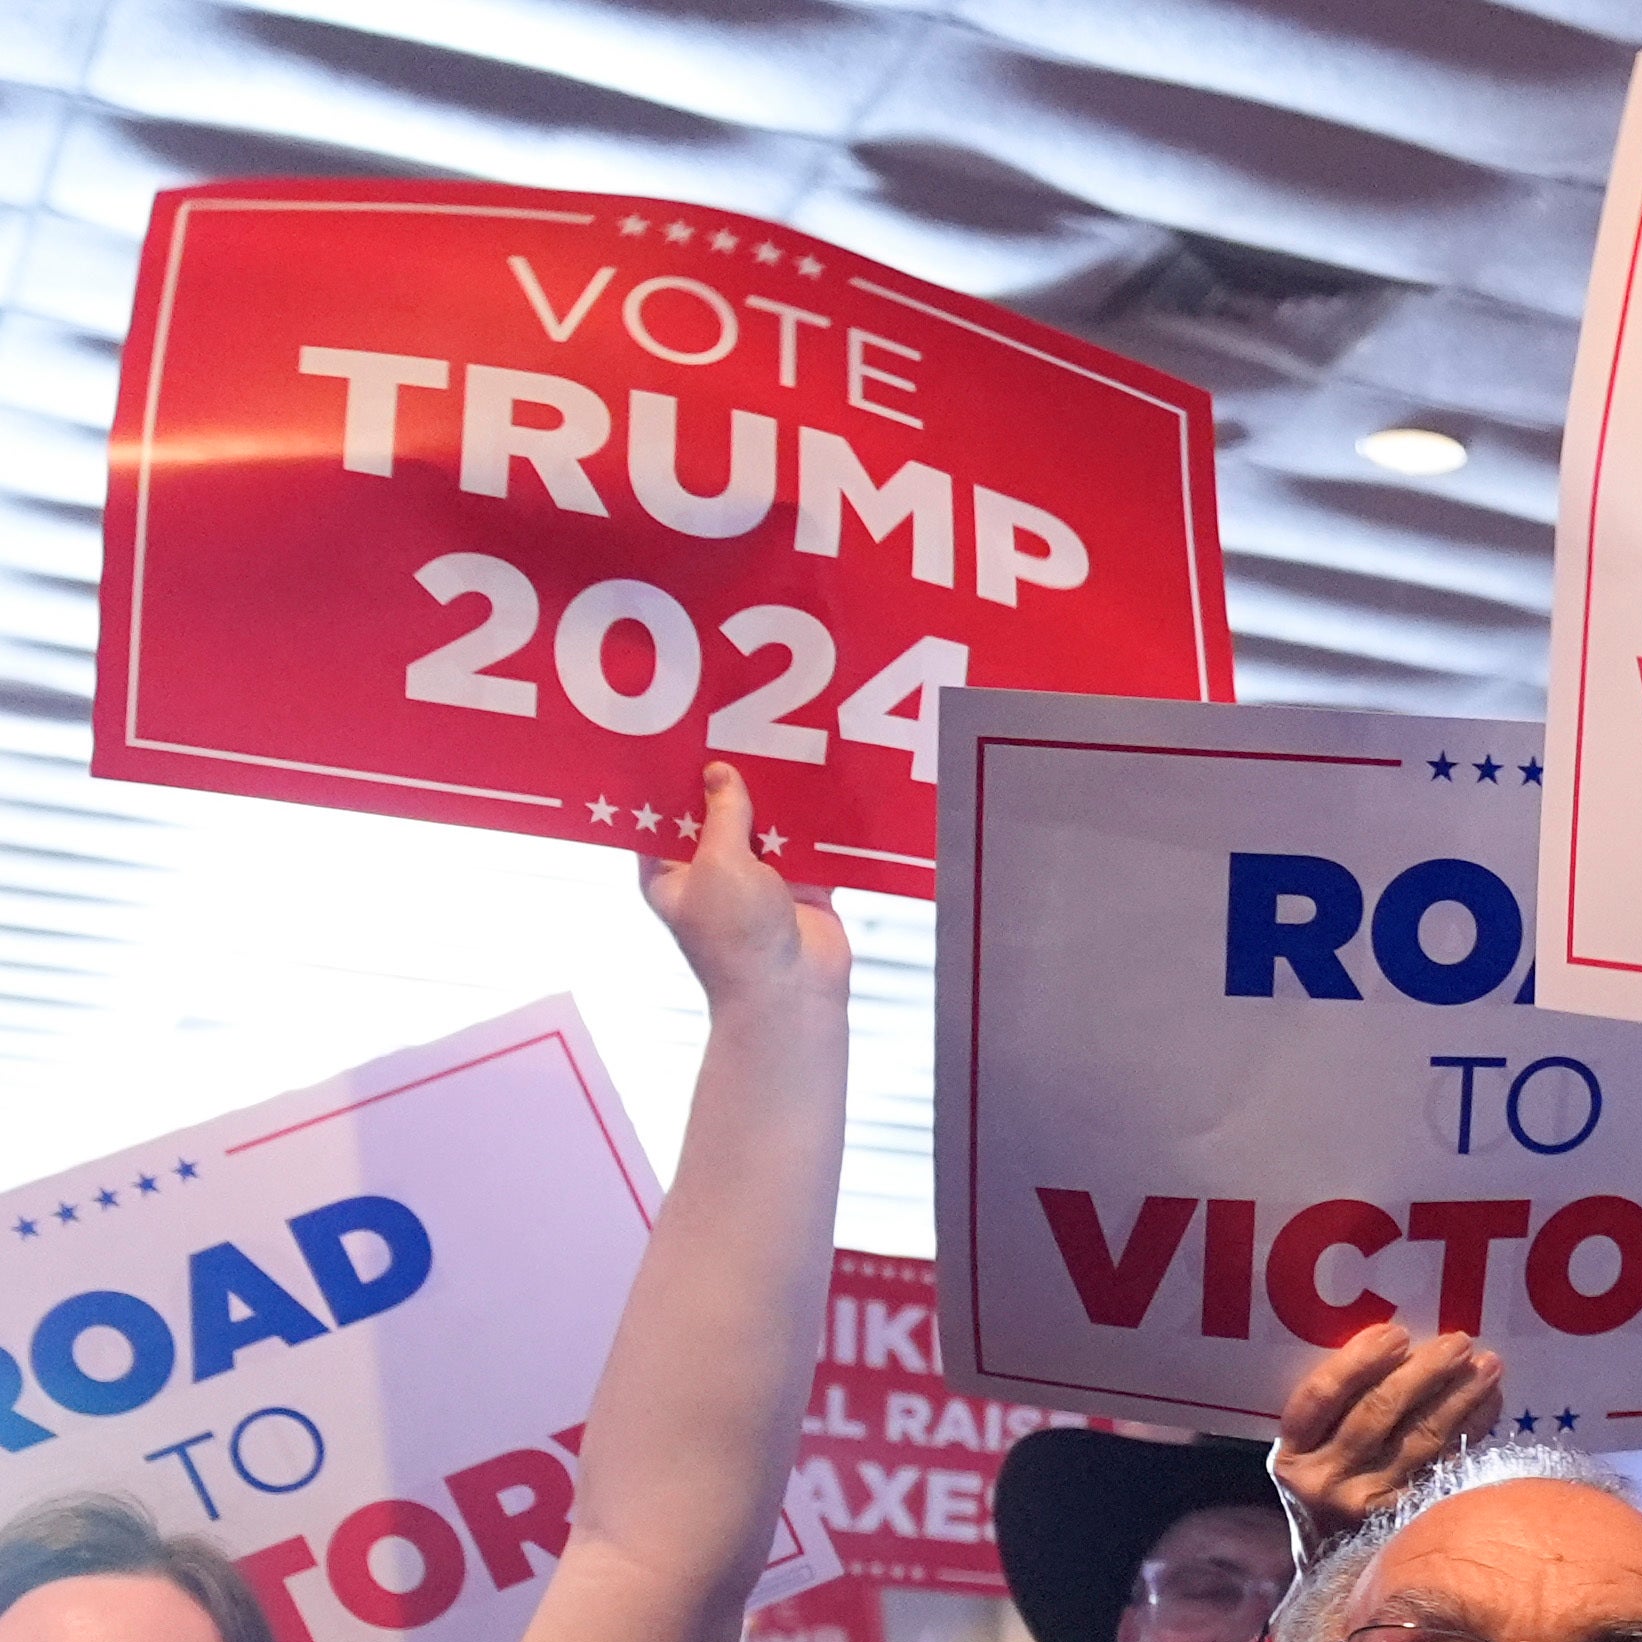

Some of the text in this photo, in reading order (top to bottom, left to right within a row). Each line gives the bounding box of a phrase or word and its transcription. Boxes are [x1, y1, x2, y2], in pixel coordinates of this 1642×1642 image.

[508, 254, 924, 431] VOTE
[298, 344, 1091, 608] TRUMP
[404, 552, 970, 786] 2024
[1224, 852, 1537, 1005] RO
[1430, 1055, 1602, 1155] TO
[144, 1406, 324, 1521] TO
[795, 1456, 997, 1544] AXE
